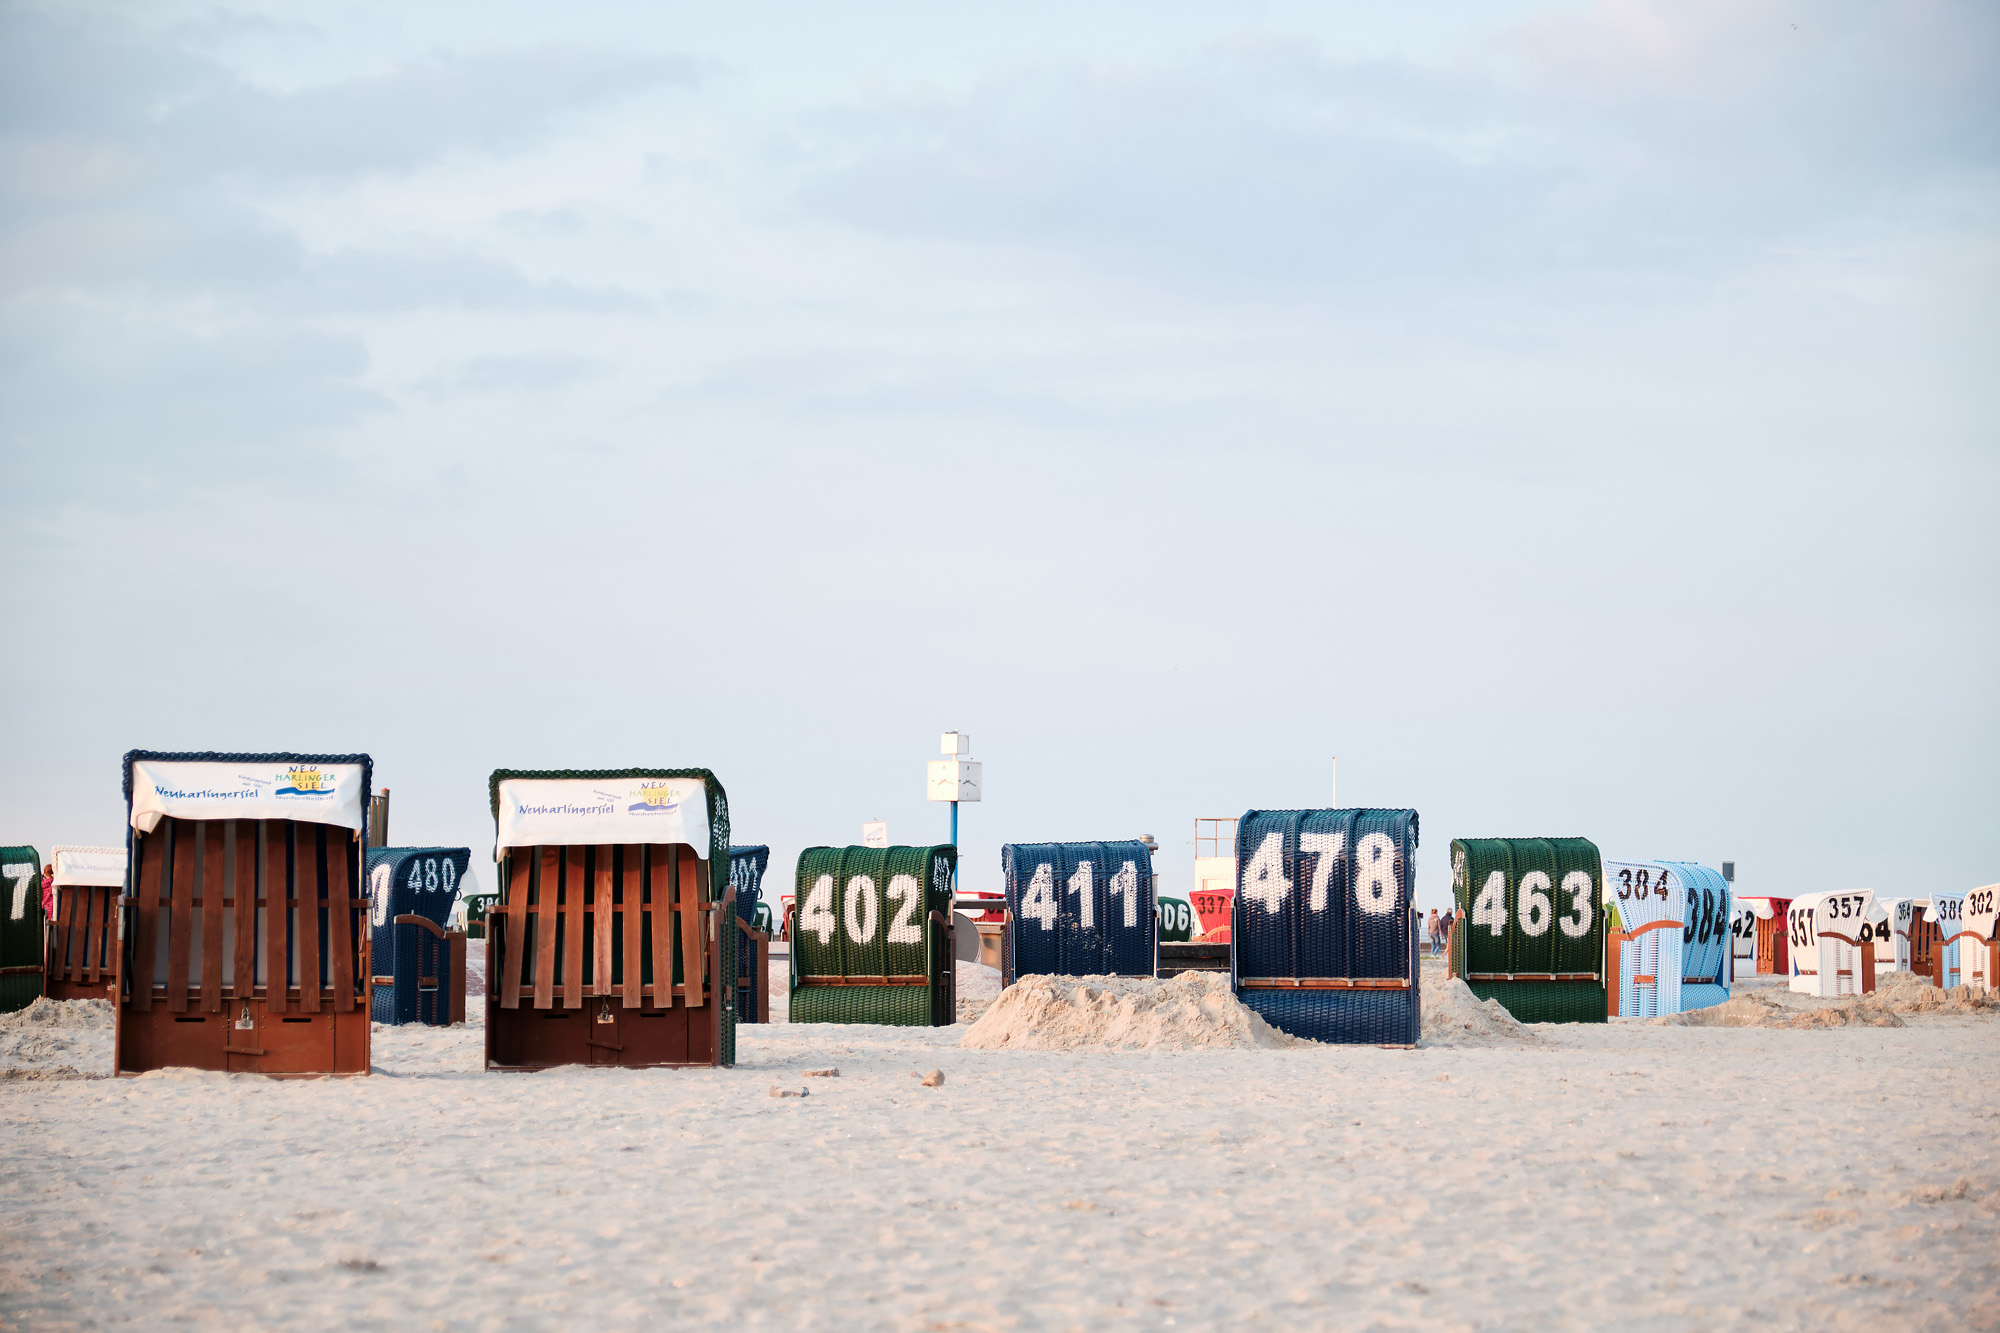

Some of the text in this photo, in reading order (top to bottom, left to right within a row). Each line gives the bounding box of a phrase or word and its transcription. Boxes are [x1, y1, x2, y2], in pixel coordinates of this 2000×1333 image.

[275, 773, 337, 782] HARLINGER
[289, 765, 317, 774] NEU
[297, 781, 328, 790] SIEL
[629, 789, 681, 798] HARLINGER
[641, 781, 666, 790] NEU
[407, 857, 456, 895] 480
[1241, 831, 1400, 916] 478
[1618, 867, 1670, 902] 384
[800, 873, 922, 945] 402
[1020, 859, 1138, 932] 411
[1198, 896, 1225, 914] 337
[1471, 870, 1594, 939] 463
[1828, 895, 1865, 919] 357
[1969, 890, 1993, 916] 302
[1683, 887, 1728, 945] 384
[1789, 908, 1815, 947] 357
